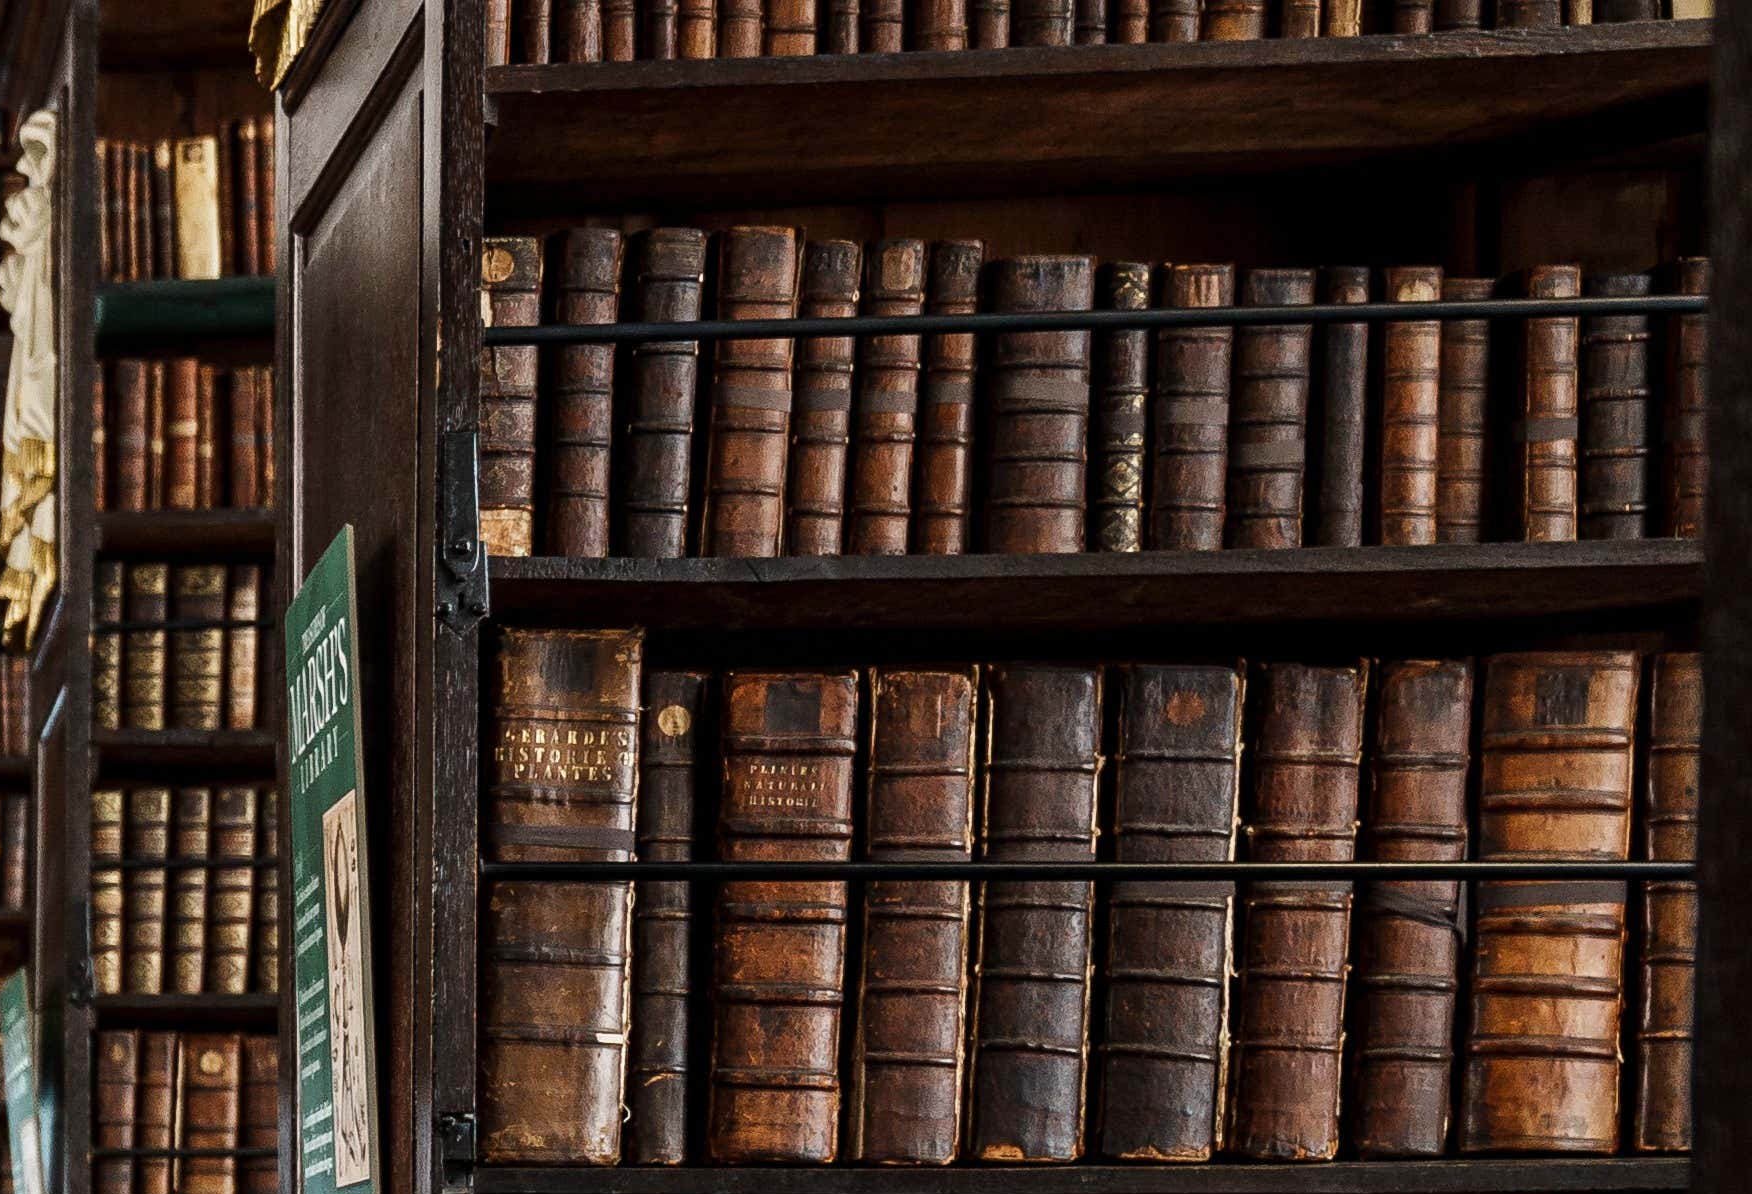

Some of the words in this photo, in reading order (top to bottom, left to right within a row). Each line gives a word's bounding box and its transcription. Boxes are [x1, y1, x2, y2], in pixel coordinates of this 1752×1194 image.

[289, 615, 349, 765] MARSH'S
[300, 725, 339, 795] LIBRARY
[513, 763, 613, 782] PLANTES
